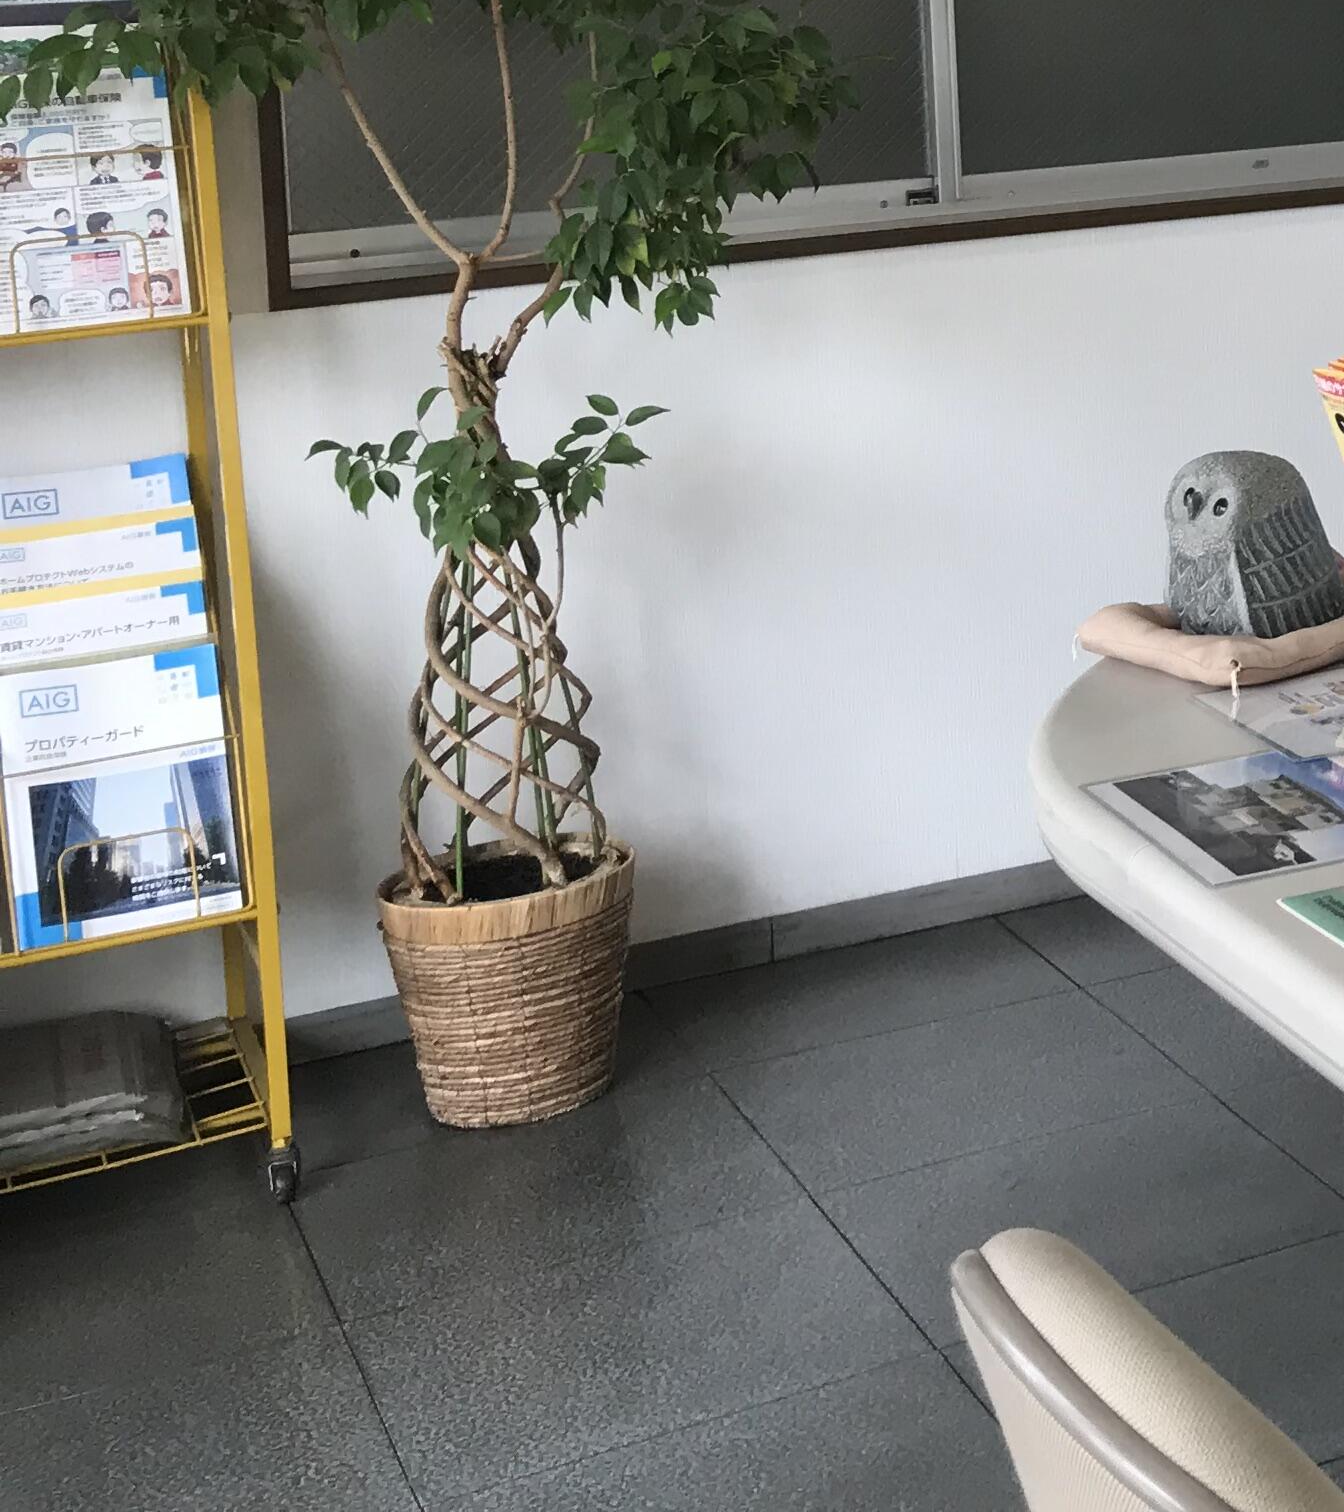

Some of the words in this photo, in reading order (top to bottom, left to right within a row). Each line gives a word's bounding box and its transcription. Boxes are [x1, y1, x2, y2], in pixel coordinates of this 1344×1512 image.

[10, 494, 51, 513] AIG
[27, 690, 71, 712] AIG
[25, 725, 145, 753] プロパティーガード
